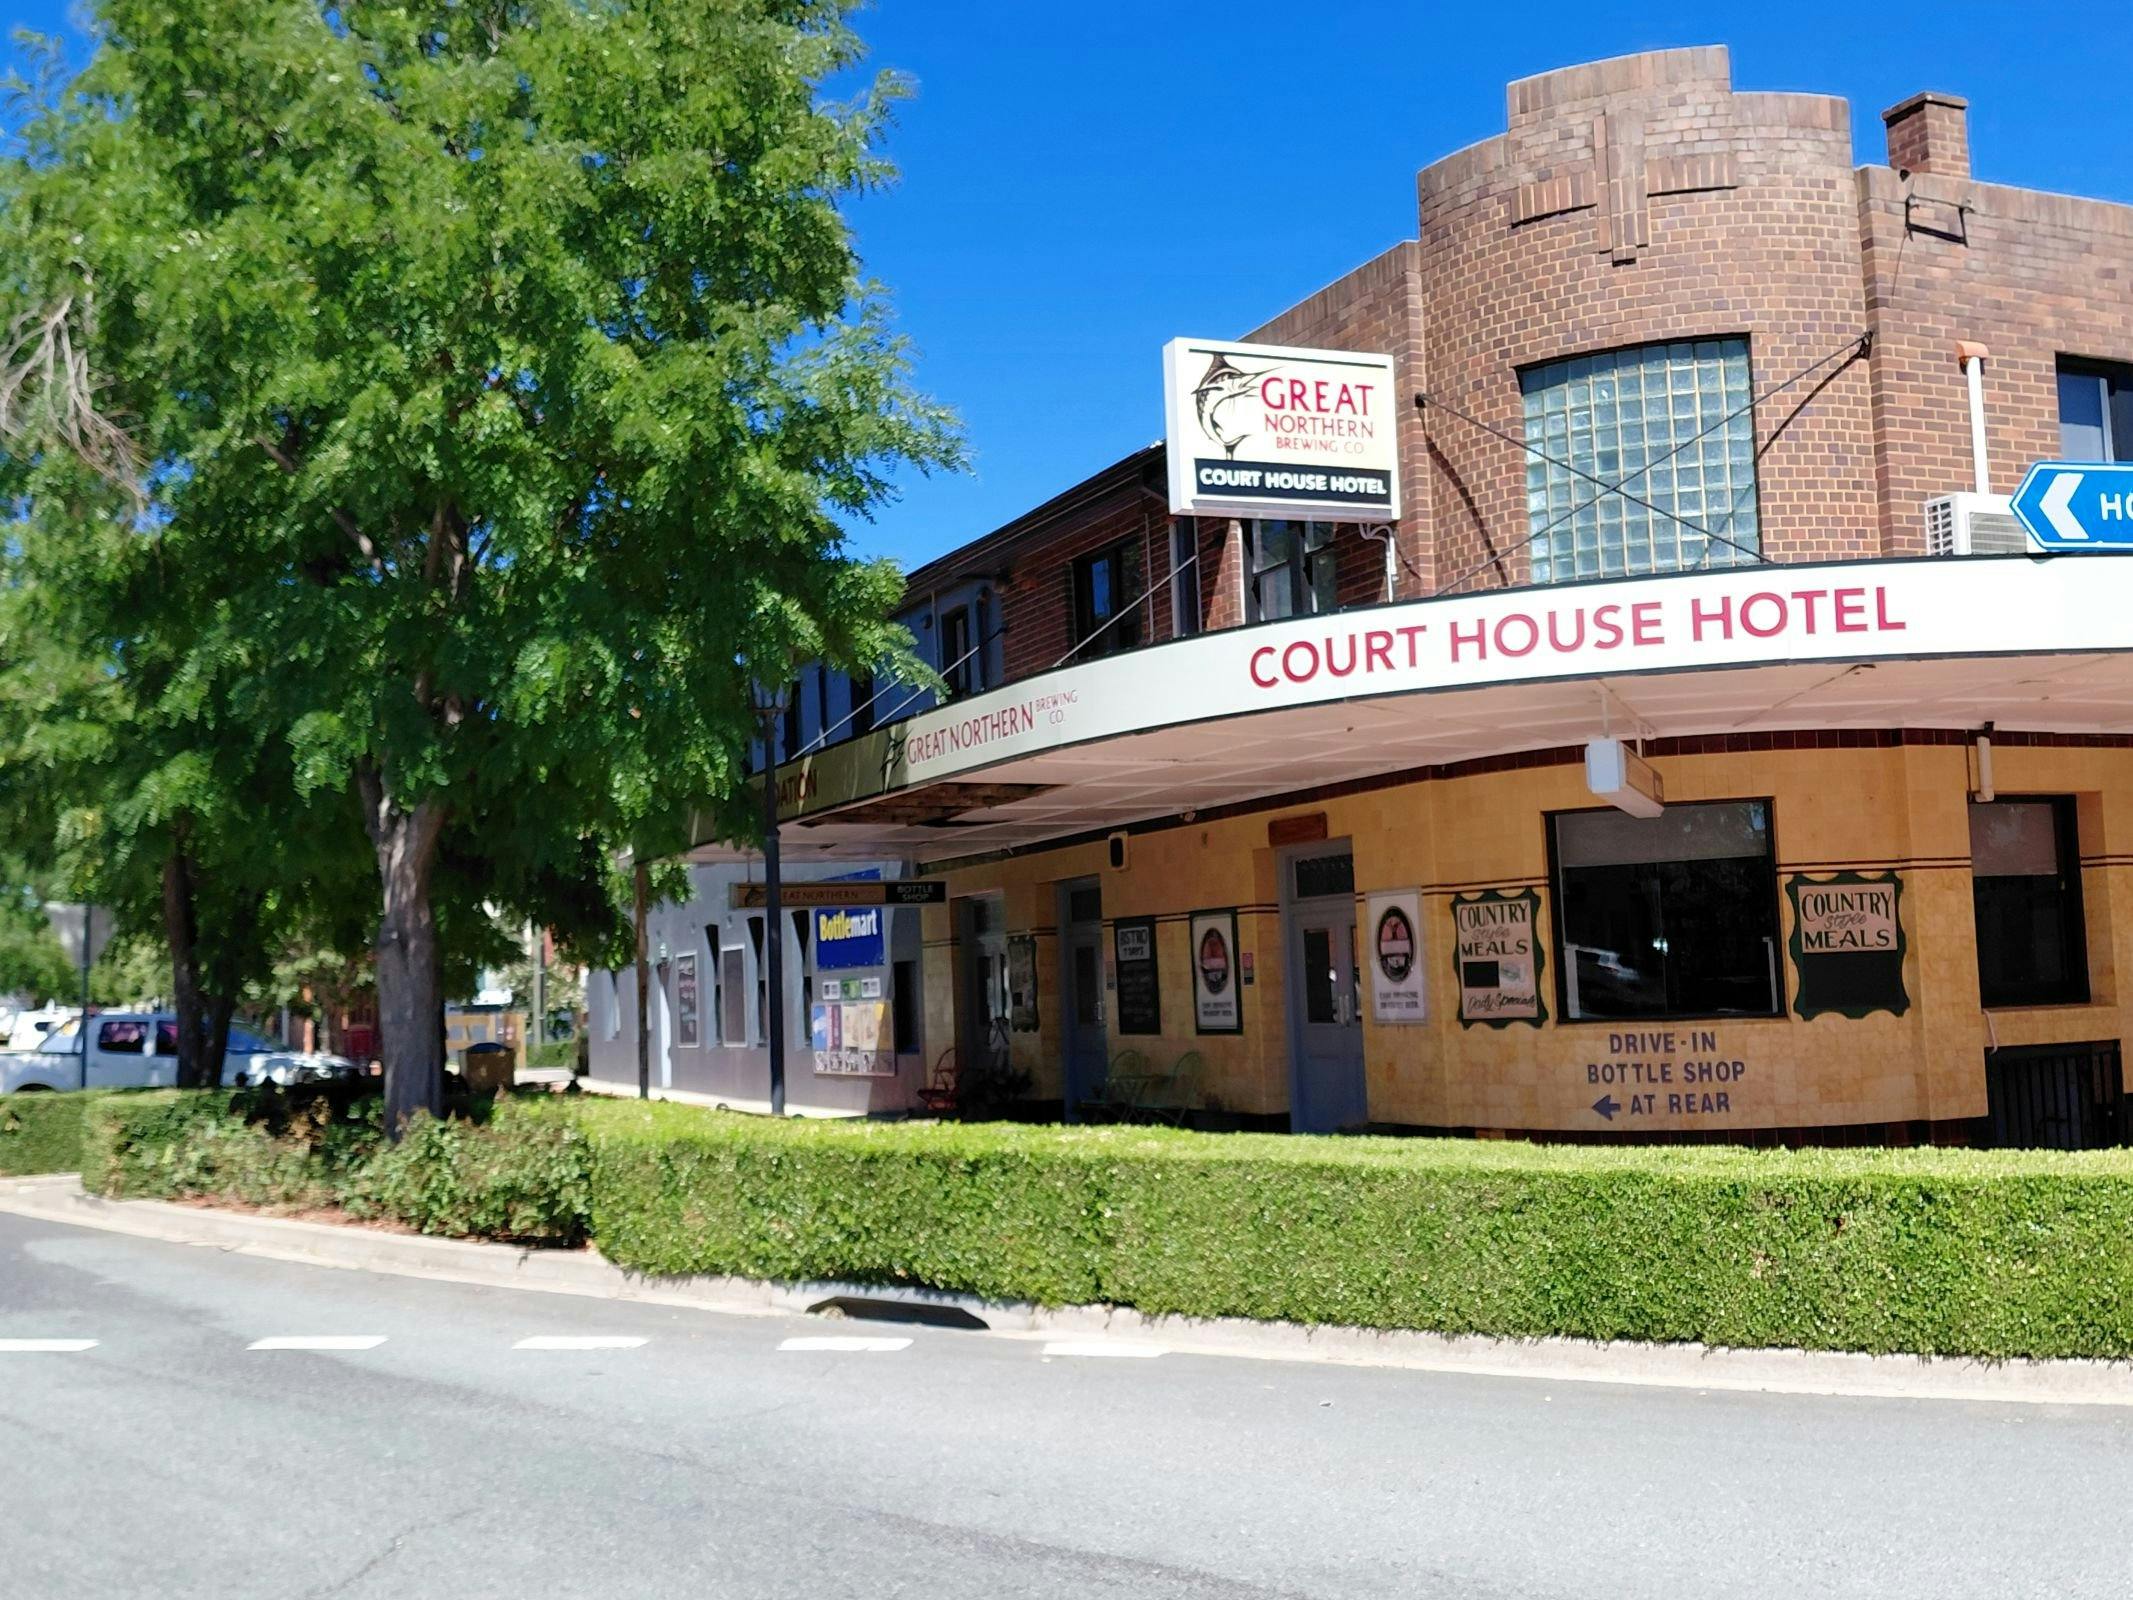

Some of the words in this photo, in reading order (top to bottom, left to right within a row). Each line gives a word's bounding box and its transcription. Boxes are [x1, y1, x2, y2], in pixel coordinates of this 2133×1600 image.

[1261, 377, 1375, 417] GREAT
[1265, 413, 1374, 438] NORTHERN
[1276, 436, 1338, 453] BREWING
[1200, 468, 1263, 488] COURT
[1265, 471, 1328, 491] HOUSE
[1330, 475, 1387, 495] HOTEL
[1249, 625, 1428, 689] COURT
[1450, 601, 1666, 663] HOUSE
[1691, 586, 1907, 642] HOTEL
[907, 729, 947, 765] GREAT
[950, 701, 1035, 751] NORTHERN
[1035, 689, 1078, 713] BREWING
[802, 890, 858, 900] NORTHERN
[896, 885, 933, 894] BOTTLE
[901, 893, 929, 902] SHOP
[1459, 902, 1528, 932] COUNTRY
[1802, 892, 1892, 921] COUNTRY
[819, 909, 878, 942] Bottlemart
[1461, 939, 1529, 957] MEALS
[1804, 929, 1890, 949] MEALS
[1587, 1062, 1673, 1084] BOTTLE
[1683, 1060, 1746, 1084] SHOP
[1631, 1094, 1656, 1115] AT
[1668, 1092, 1731, 1115] REAR
